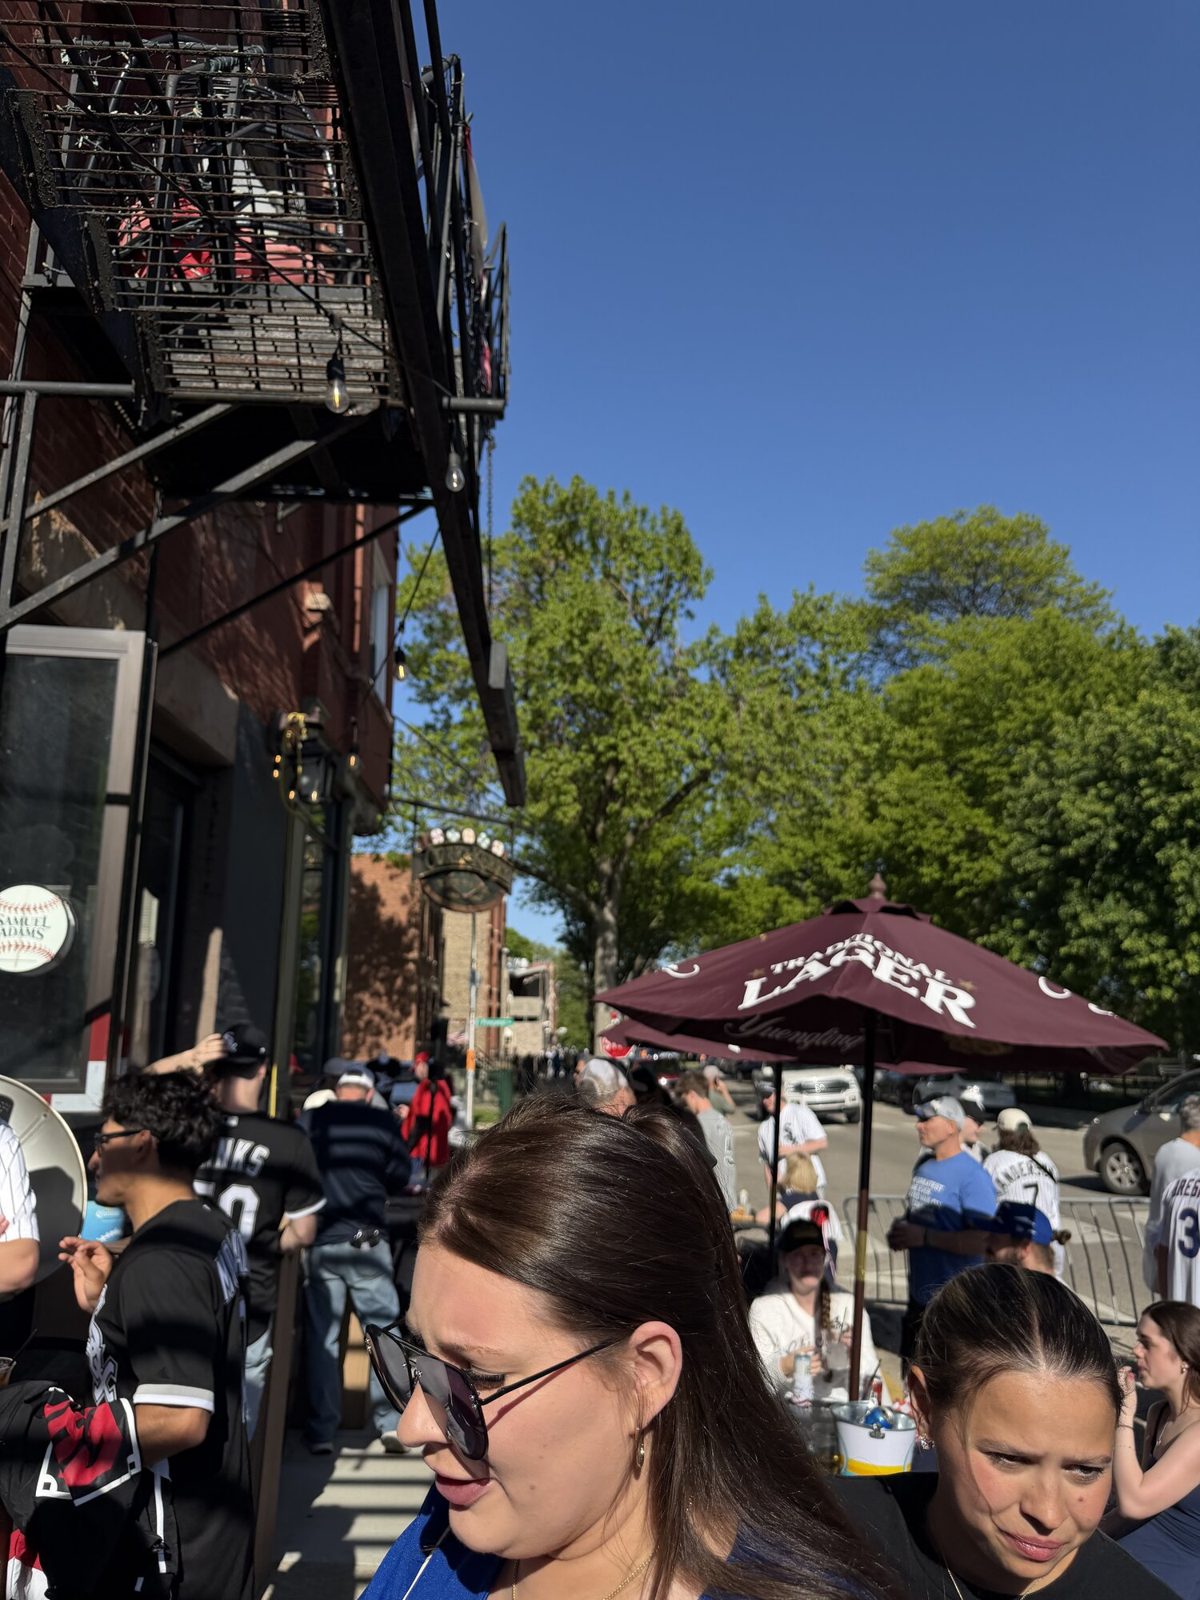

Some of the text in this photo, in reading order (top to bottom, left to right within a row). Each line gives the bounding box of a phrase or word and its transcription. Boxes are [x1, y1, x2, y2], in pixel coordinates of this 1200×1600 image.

[0, 925, 44, 941] ADAMS
[770, 932, 953, 985] TRADITIONAL
[737, 940, 977, 1030] LAGER
